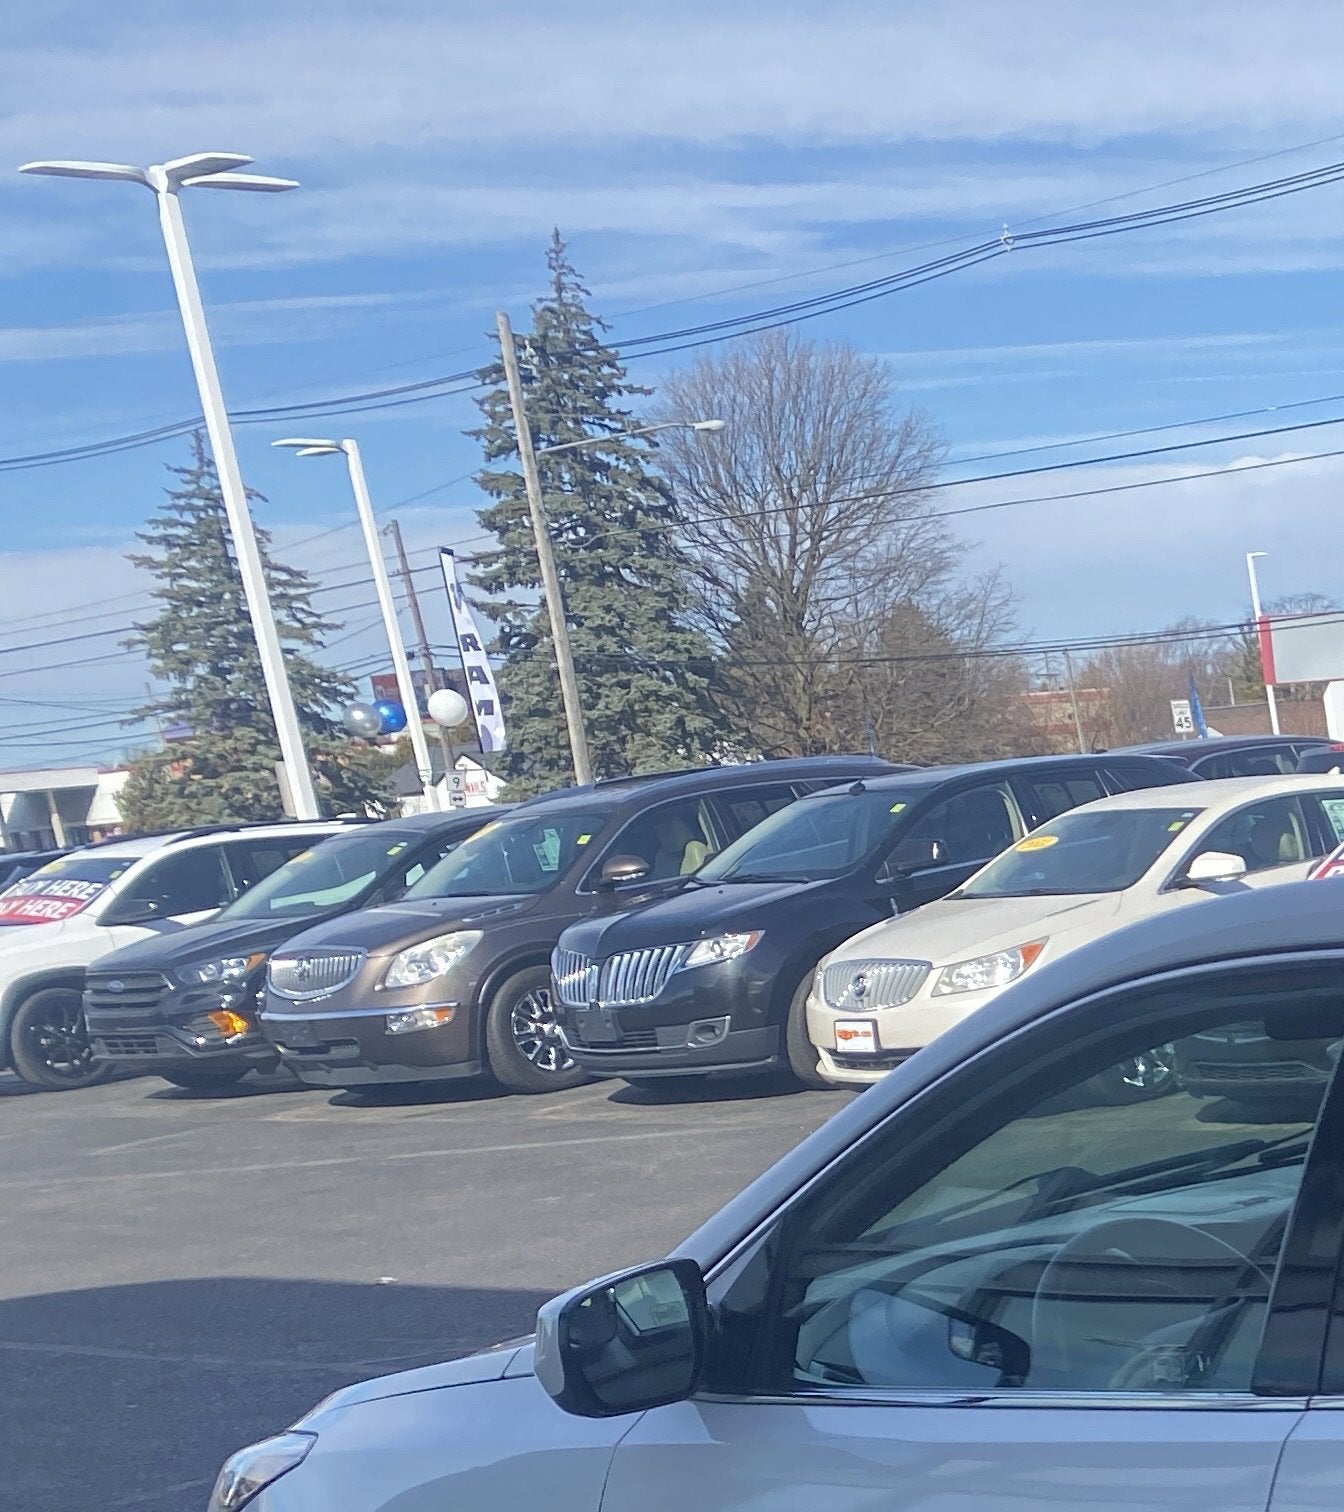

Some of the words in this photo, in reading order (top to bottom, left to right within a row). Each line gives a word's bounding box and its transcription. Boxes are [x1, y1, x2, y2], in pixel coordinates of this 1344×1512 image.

[1176, 716, 1192, 729] 45
[452, 776, 461, 789] 9
[40, 879, 104, 900] HERE
[16, 898, 76, 919] HERE
